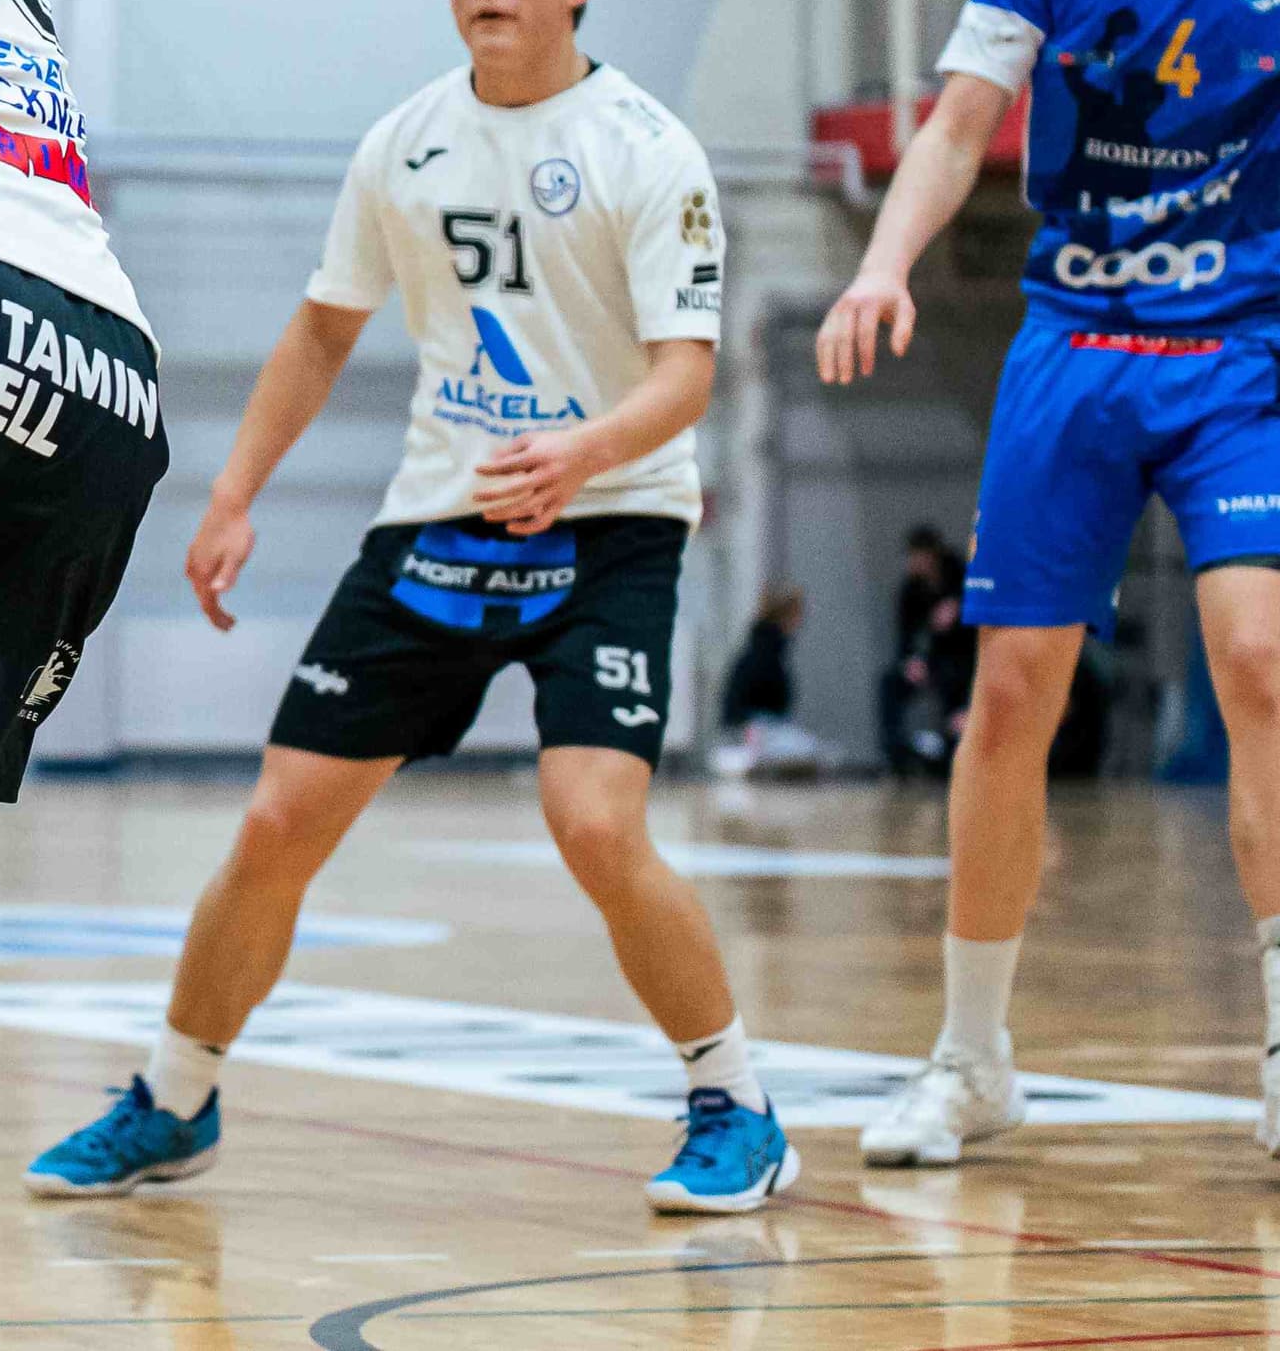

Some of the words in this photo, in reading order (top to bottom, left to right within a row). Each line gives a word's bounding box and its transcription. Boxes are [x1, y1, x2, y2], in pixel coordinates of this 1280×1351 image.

[1156, 19, 1201, 99] 4
[441, 207, 534, 296] 51
[485, 567, 576, 592] AUTO
[595, 645, 651, 696] 51
